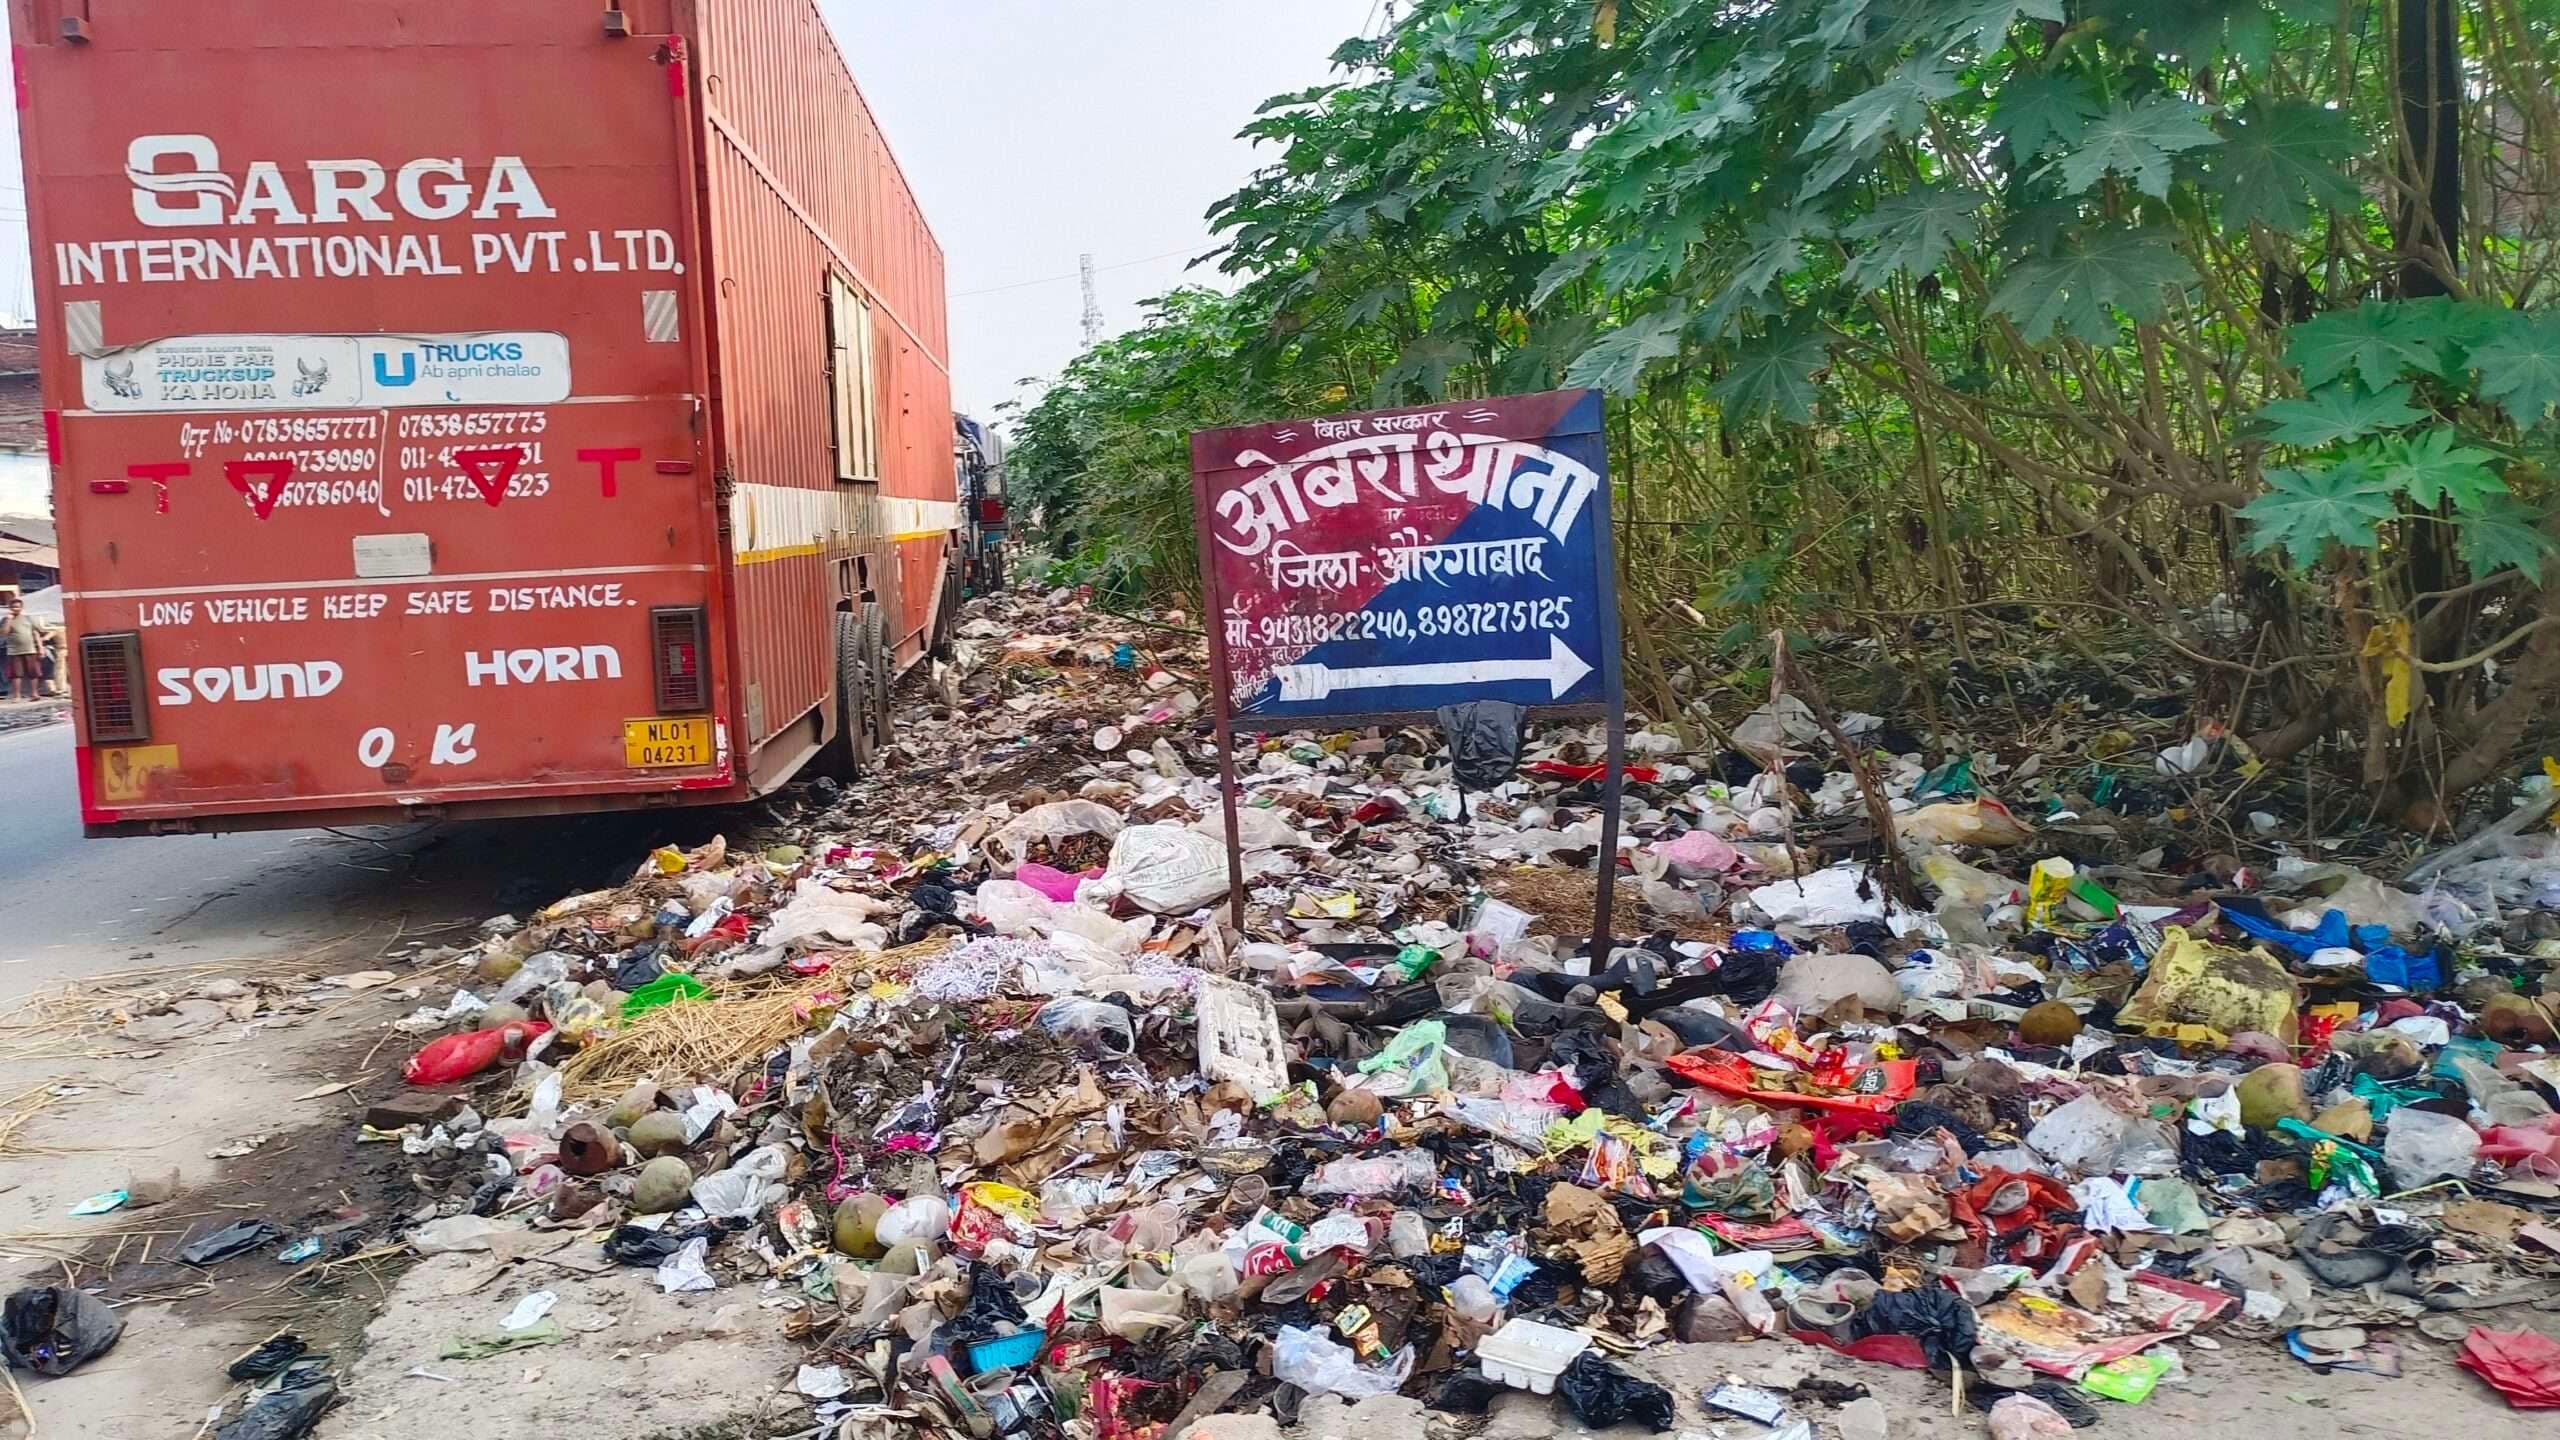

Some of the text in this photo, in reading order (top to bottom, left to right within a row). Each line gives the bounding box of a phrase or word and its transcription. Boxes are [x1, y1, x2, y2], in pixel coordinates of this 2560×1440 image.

[55, 234, 462, 285] INTERNATIONAL
[157, 354, 274, 368] PHONE PAR
[419, 343, 522, 362] TRUCKS
[160, 367, 275, 383] TRUCKSUP
[421, 364, 541, 380] Ab apni chalao
[161, 383, 276, 400] KA HONA
[399, 411, 547, 438] 07838657773
[1312, 411, 1452, 441] बिहार सरकार
[1214, 431, 1600, 556] ओबरा थाना
[138, 583, 638, 627] LONG VEHICLE KEEP SAFE DISTANCE.
[464, 644, 623, 687] HORN
[157, 660, 343, 706] SOUND
[648, 722, 691, 742] NL01
